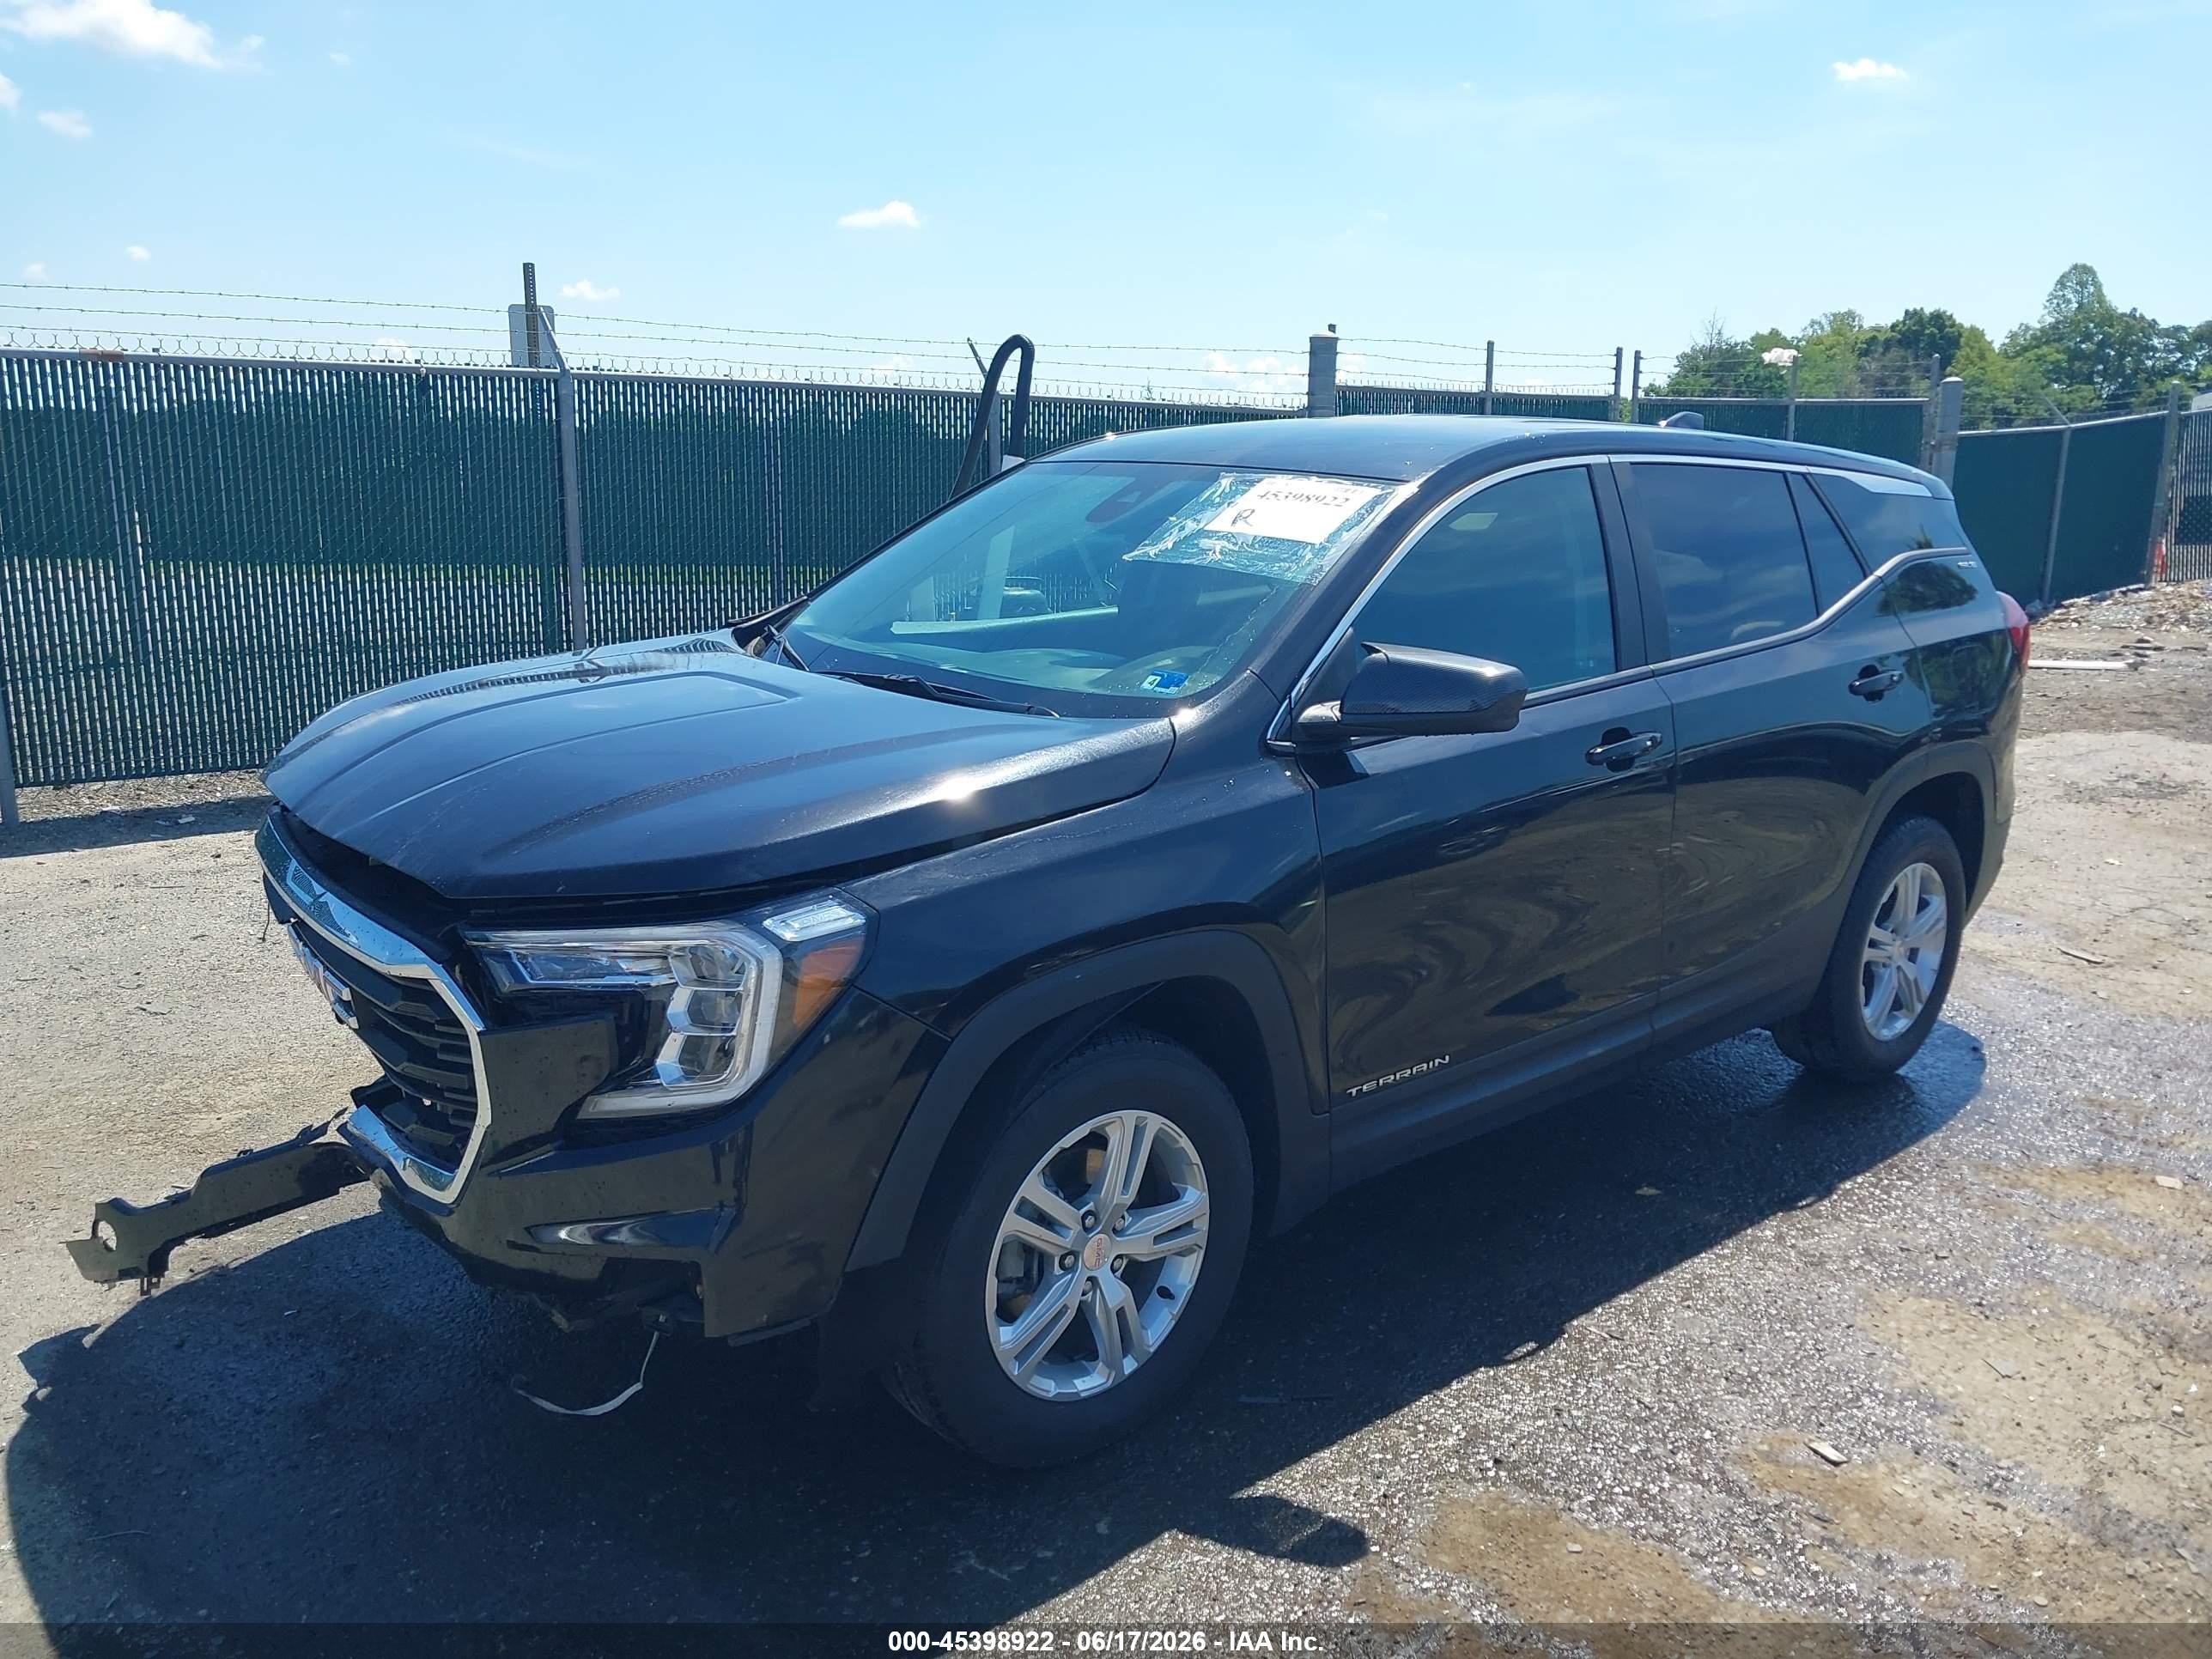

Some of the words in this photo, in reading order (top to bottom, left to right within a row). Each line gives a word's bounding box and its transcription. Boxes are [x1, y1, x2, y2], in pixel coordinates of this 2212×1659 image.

[1257, 490, 1351, 507] 45398922
[1346, 1054, 1449, 1097] TERRAIN
[1094, 1237, 1103, 1267] GMC
